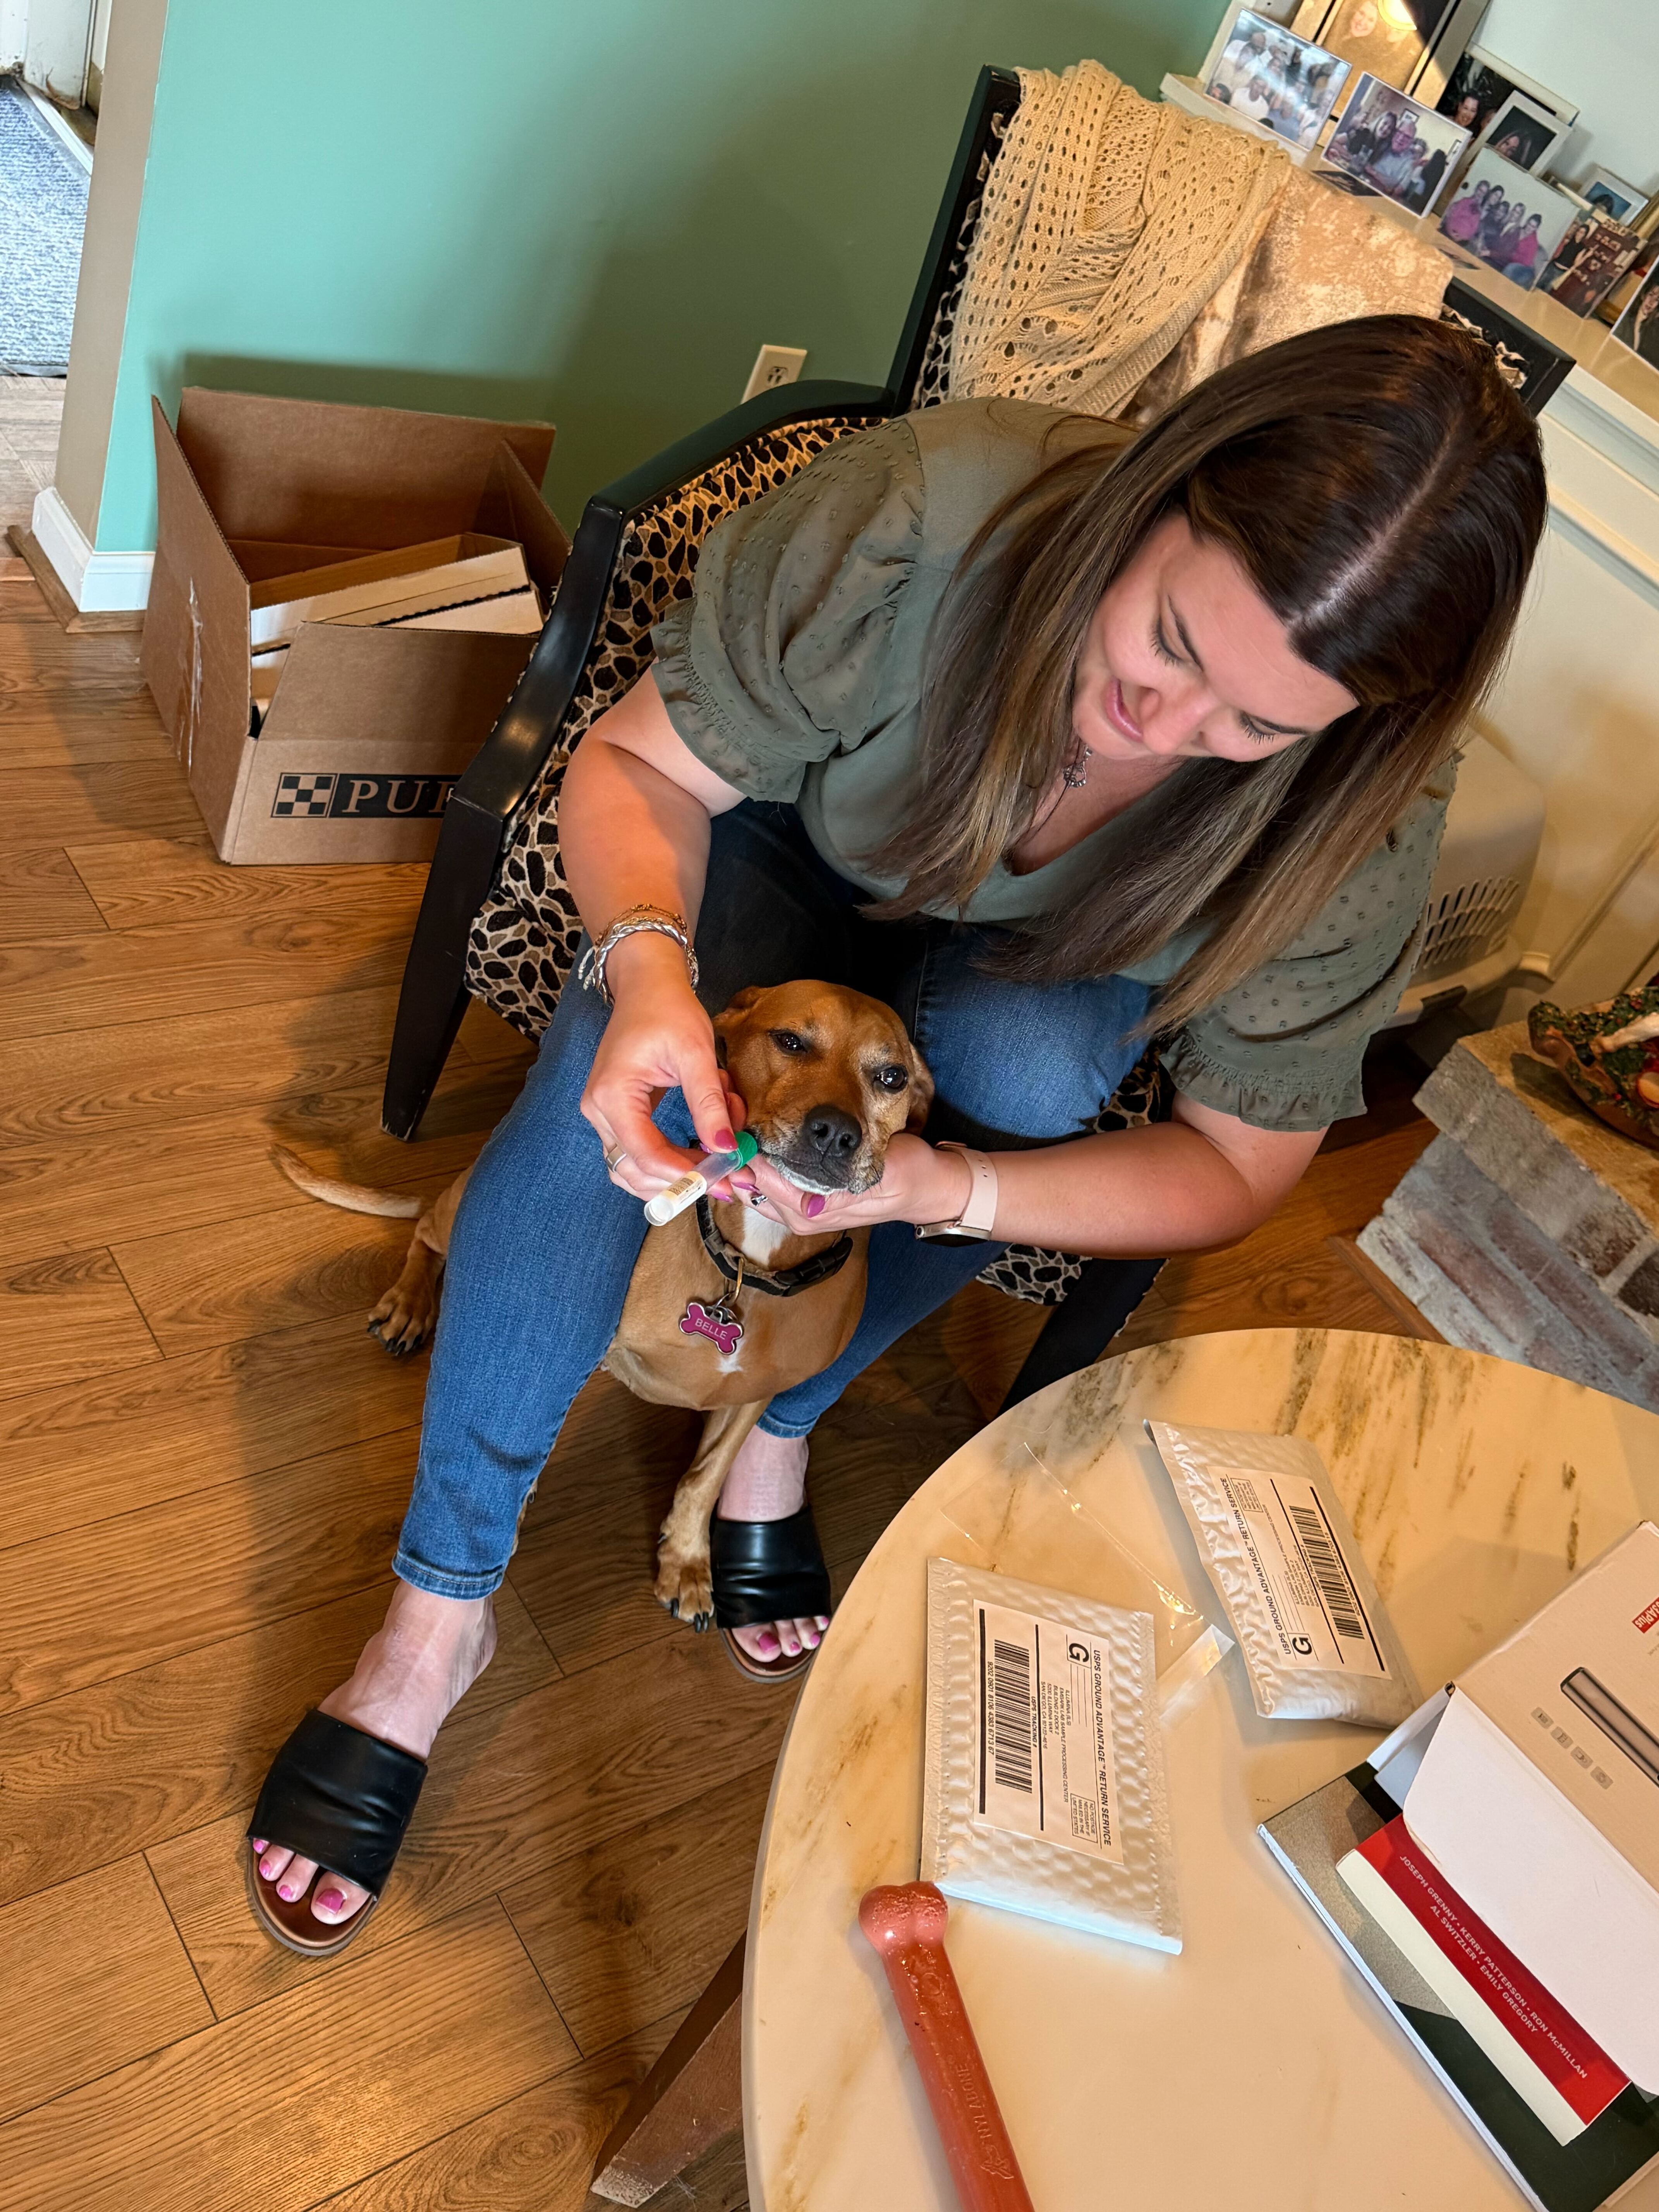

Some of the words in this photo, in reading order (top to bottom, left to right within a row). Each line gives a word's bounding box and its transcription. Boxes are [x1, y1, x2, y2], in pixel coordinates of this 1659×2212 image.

[695, 1318, 728, 1340] BELLE
[1220, 1477, 1236, 1508] SERVICE
[1233, 1509, 1250, 1539] RETURN
[1265, 1595, 1283, 1631] GROUND
[1068, 1642, 1089, 1662] G
[1278, 1632, 1291, 1654] USPS
[1291, 1637, 1312, 1655] G
[1094, 1673, 1102, 1709] GROUND
[988, 1746, 994, 1755] 67
[1099, 1770, 1108, 1806] RETURN
[1101, 1807, 1111, 1846] SERVICE
[1399, 1856, 1428, 1887] JOSEPH
[1427, 1887, 1458, 1921] GRENNY
[1460, 1927, 1485, 1954] KERRY
[1484, 1956, 1527, 2007] PATTERSON
[1530, 2011, 1548, 2032] RON
[1546, 2031, 1588, 2079] McMILLAN
[1430, 1905, 1440, 1918] AL
[1440, 1917, 1477, 1960] SWITZLER
[1479, 1965, 1503, 1990] EMILY
[1502, 1992, 1538, 2032] GREGORY
